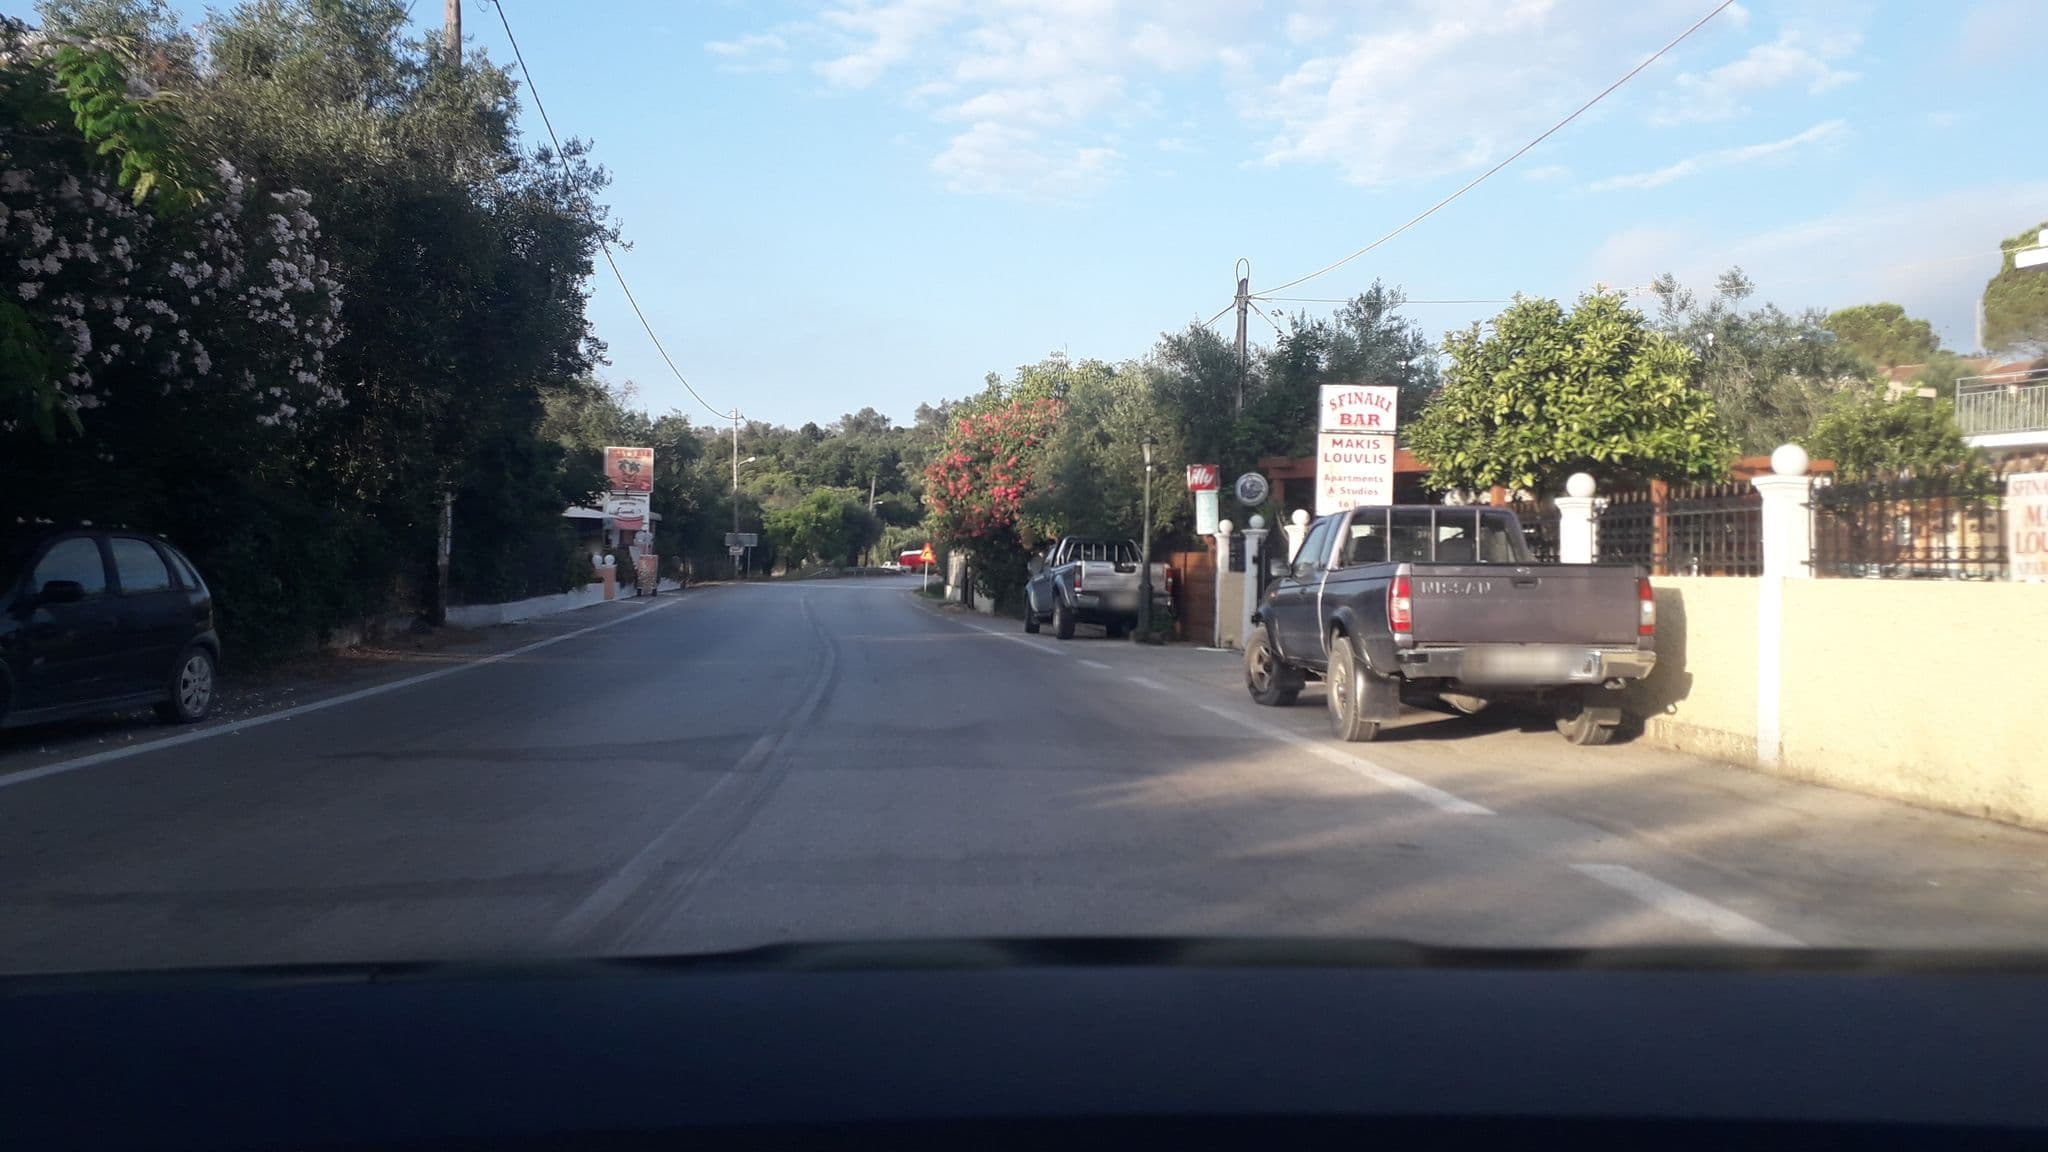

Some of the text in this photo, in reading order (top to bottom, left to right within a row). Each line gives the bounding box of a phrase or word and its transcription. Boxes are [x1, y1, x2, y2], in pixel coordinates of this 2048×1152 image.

[1329, 391, 1393, 413] SFINAKI
[1339, 413, 1381, 426] BAR
[1331, 438, 1381, 449] MAKIS
[1324, 453, 1387, 465] LOUVLIS
[1191, 467, 1214, 486] illy
[1324, 473, 1384, 484] Apartments
[1339, 486, 1379, 496] Studios
